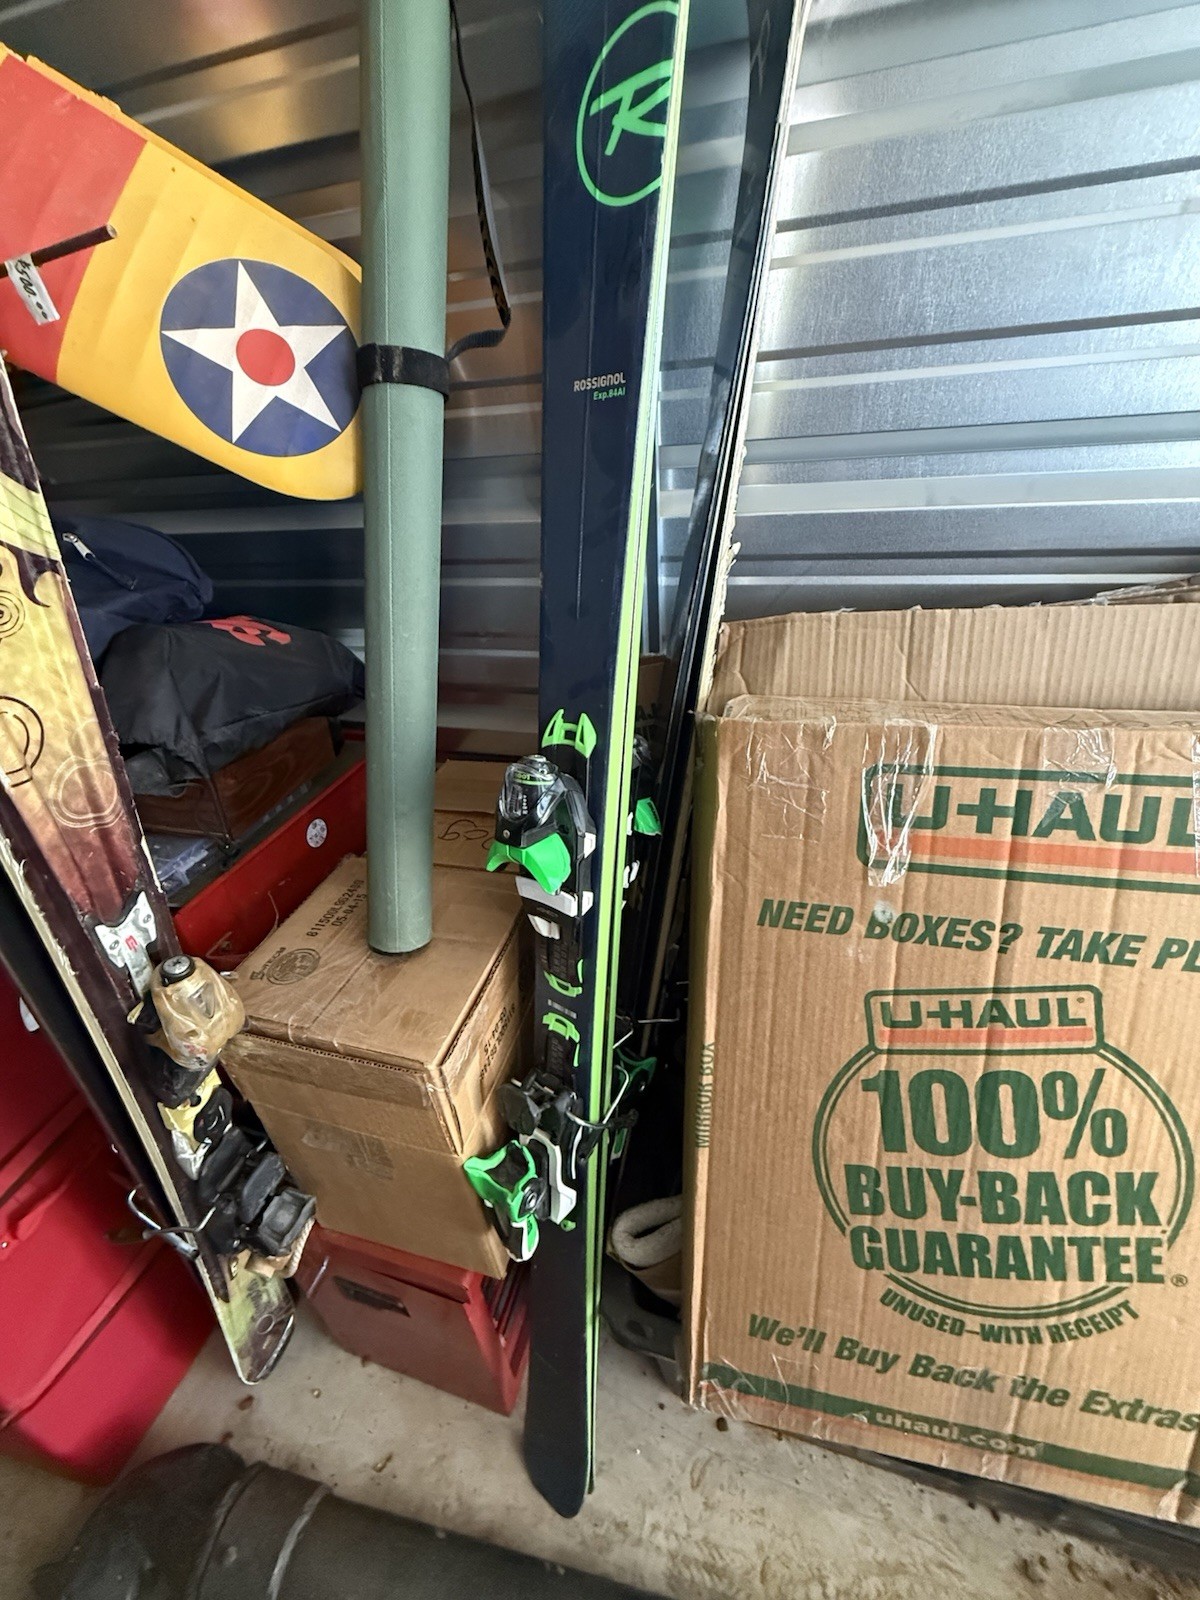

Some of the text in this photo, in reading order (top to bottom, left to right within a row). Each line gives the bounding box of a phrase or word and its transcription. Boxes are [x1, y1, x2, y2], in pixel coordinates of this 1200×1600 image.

[573, 371, 627, 392] ROSSIGNOL
[757, 899, 854, 937] NEED
[864, 904, 1022, 954] BOXES?
[1036, 926, 1147, 968] TAKE
[862, 1068, 1128, 1160] 100%
[844, 1164, 1163, 1226] BUY-BACK
[1046, 1300, 1140, 1345] RECEIPT
[748, 1314, 1200, 1433] We'll Buy Back the Extras
[876, 1412, 1040, 1457] uhaul.com
